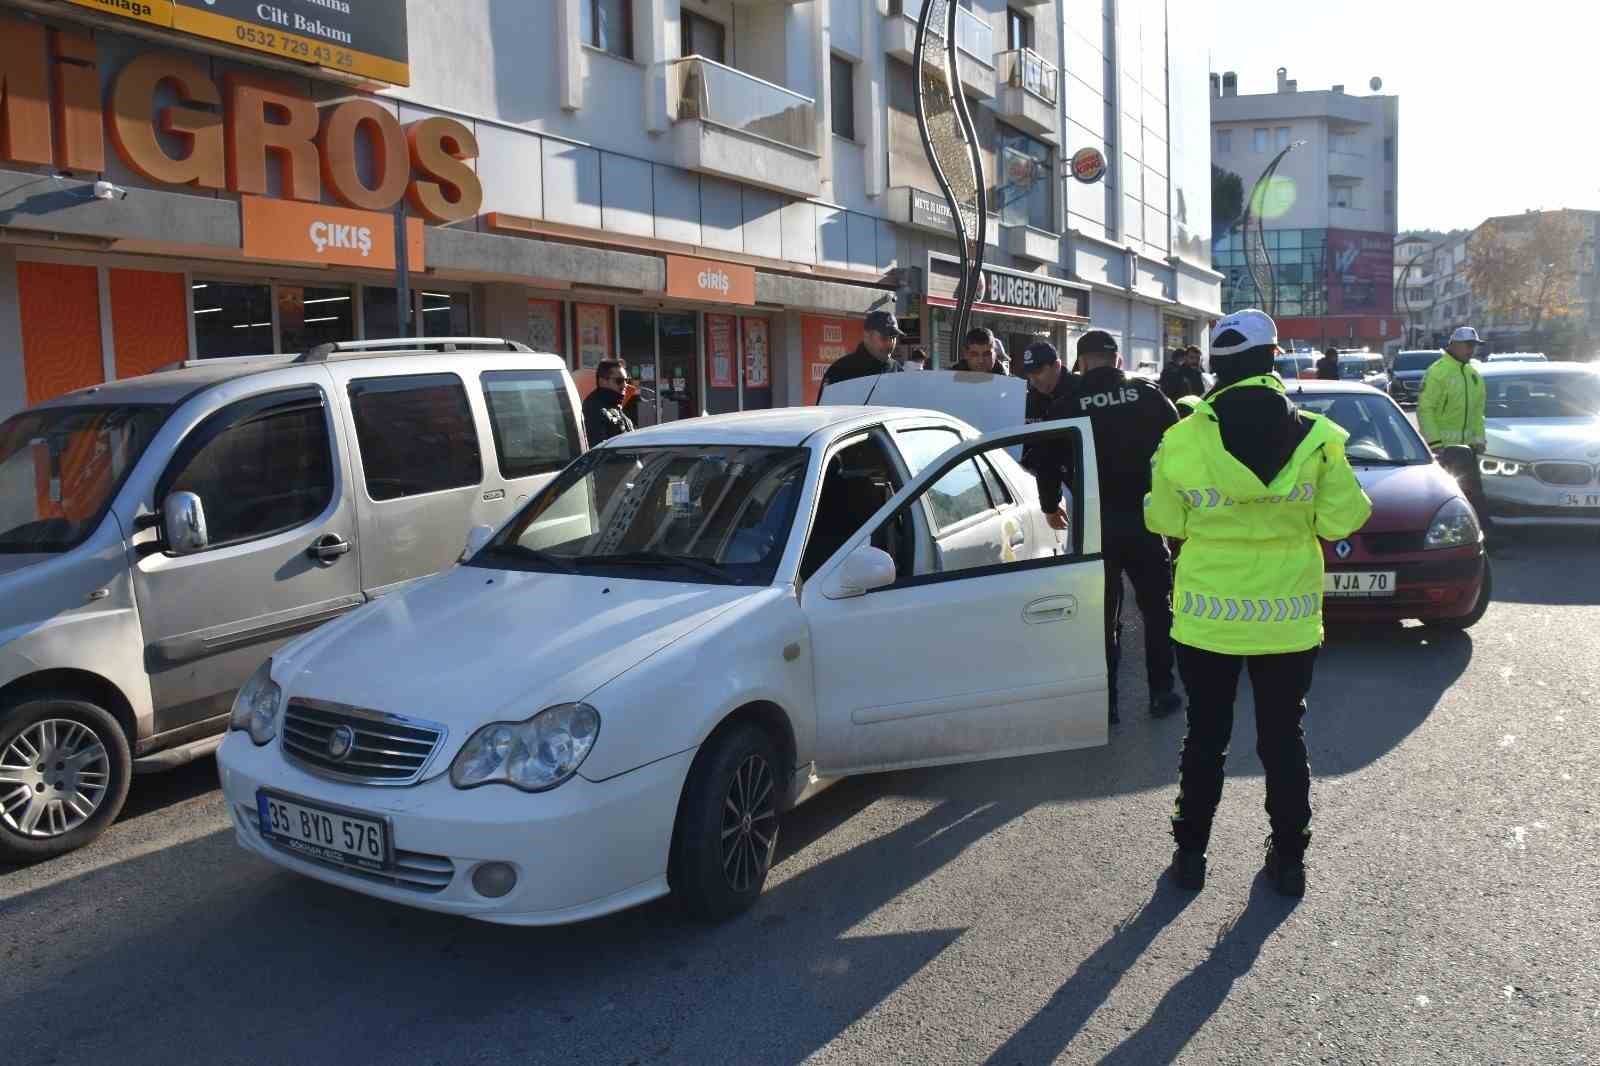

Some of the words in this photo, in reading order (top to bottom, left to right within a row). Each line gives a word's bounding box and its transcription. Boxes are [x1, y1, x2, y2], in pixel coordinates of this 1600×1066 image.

[236, 25, 276, 48] 0532
[256, 4, 288, 26] Cilt
[294, 13, 352, 44] Bakımı
[309, 220, 373, 257] ÇIKIŞ
[990, 273, 1036, 308] BURGER
[1038, 282, 1064, 314] KING
[1333, 574, 1360, 590] VJA
[1368, 574, 1387, 590] 70
[269, 801, 290, 833] 35
[299, 809, 334, 845] BYD
[342, 820, 380, 858] 576
